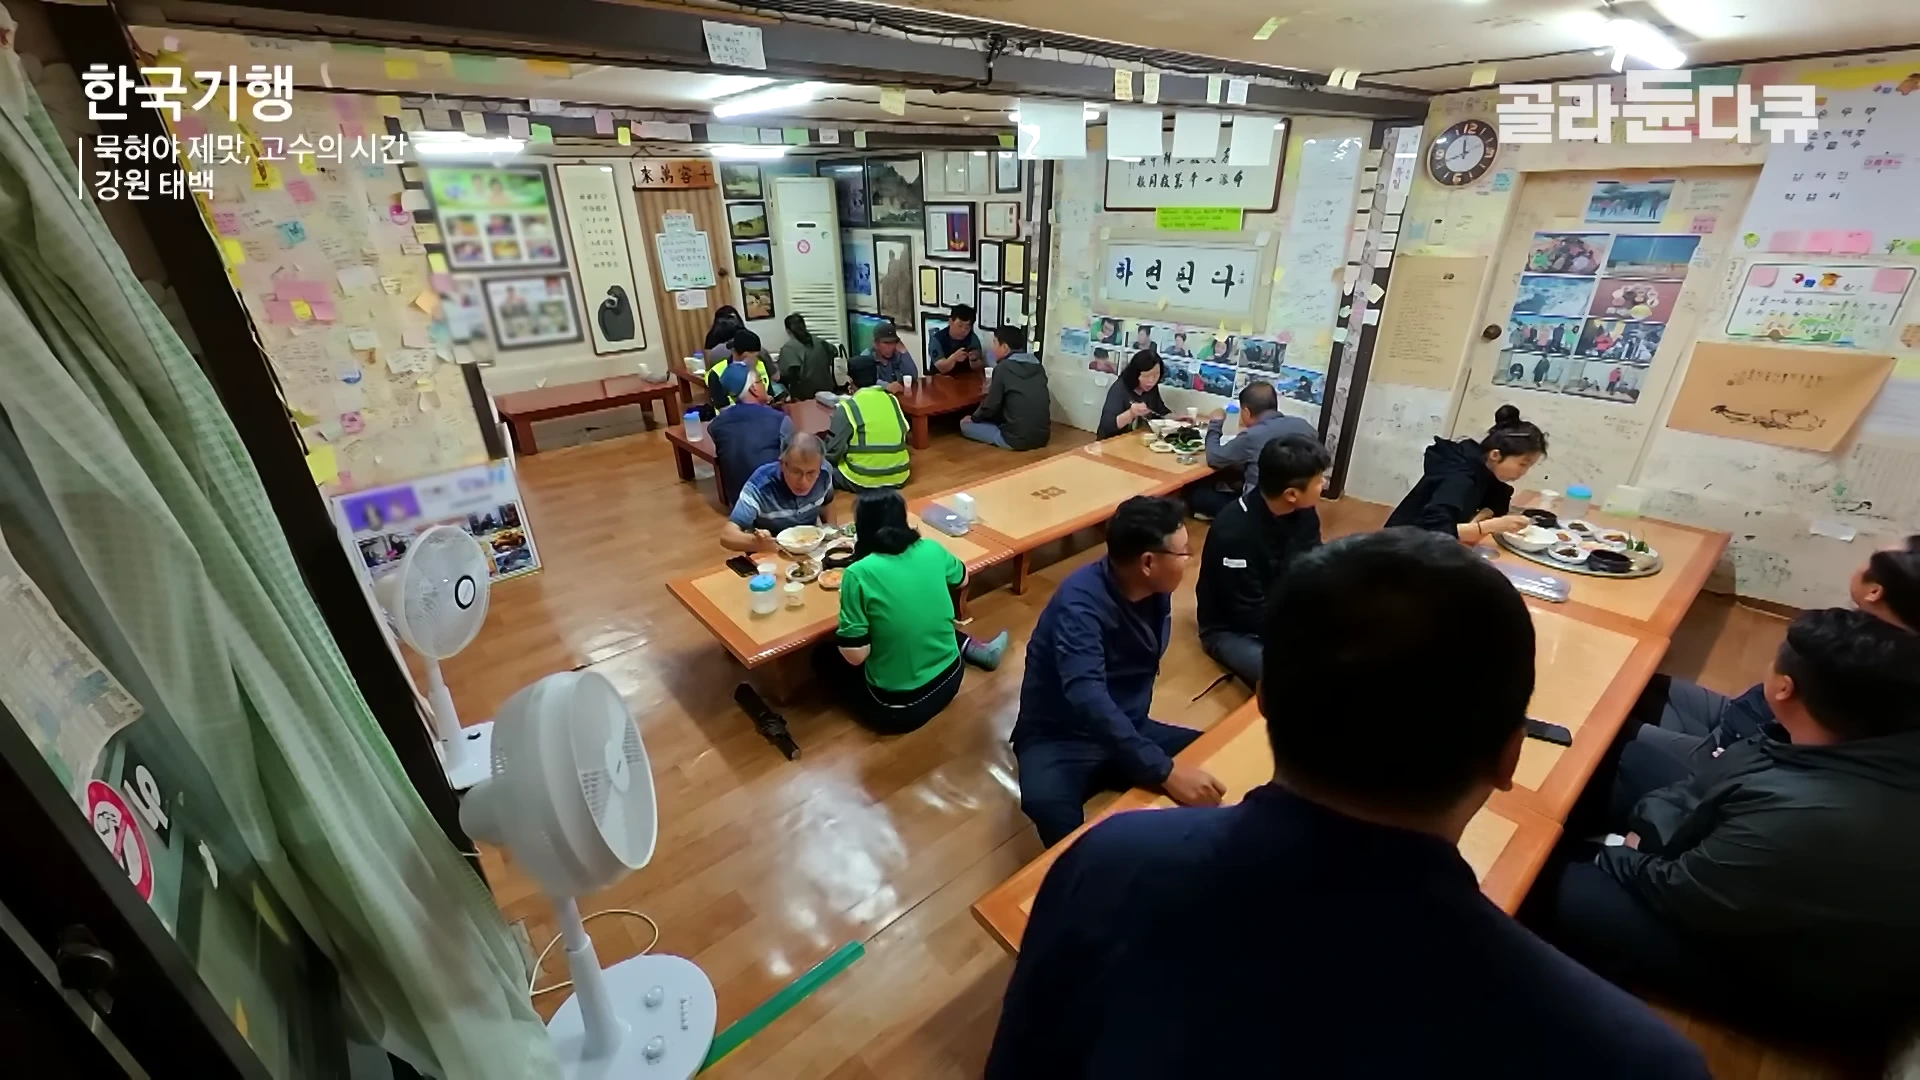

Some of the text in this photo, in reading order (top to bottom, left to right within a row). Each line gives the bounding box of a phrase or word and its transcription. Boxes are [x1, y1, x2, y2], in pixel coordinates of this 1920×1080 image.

[1463, 122, 1479, 135] 12
[1434, 149, 1446, 161] 9
[1451, 172, 1463, 185] 6
